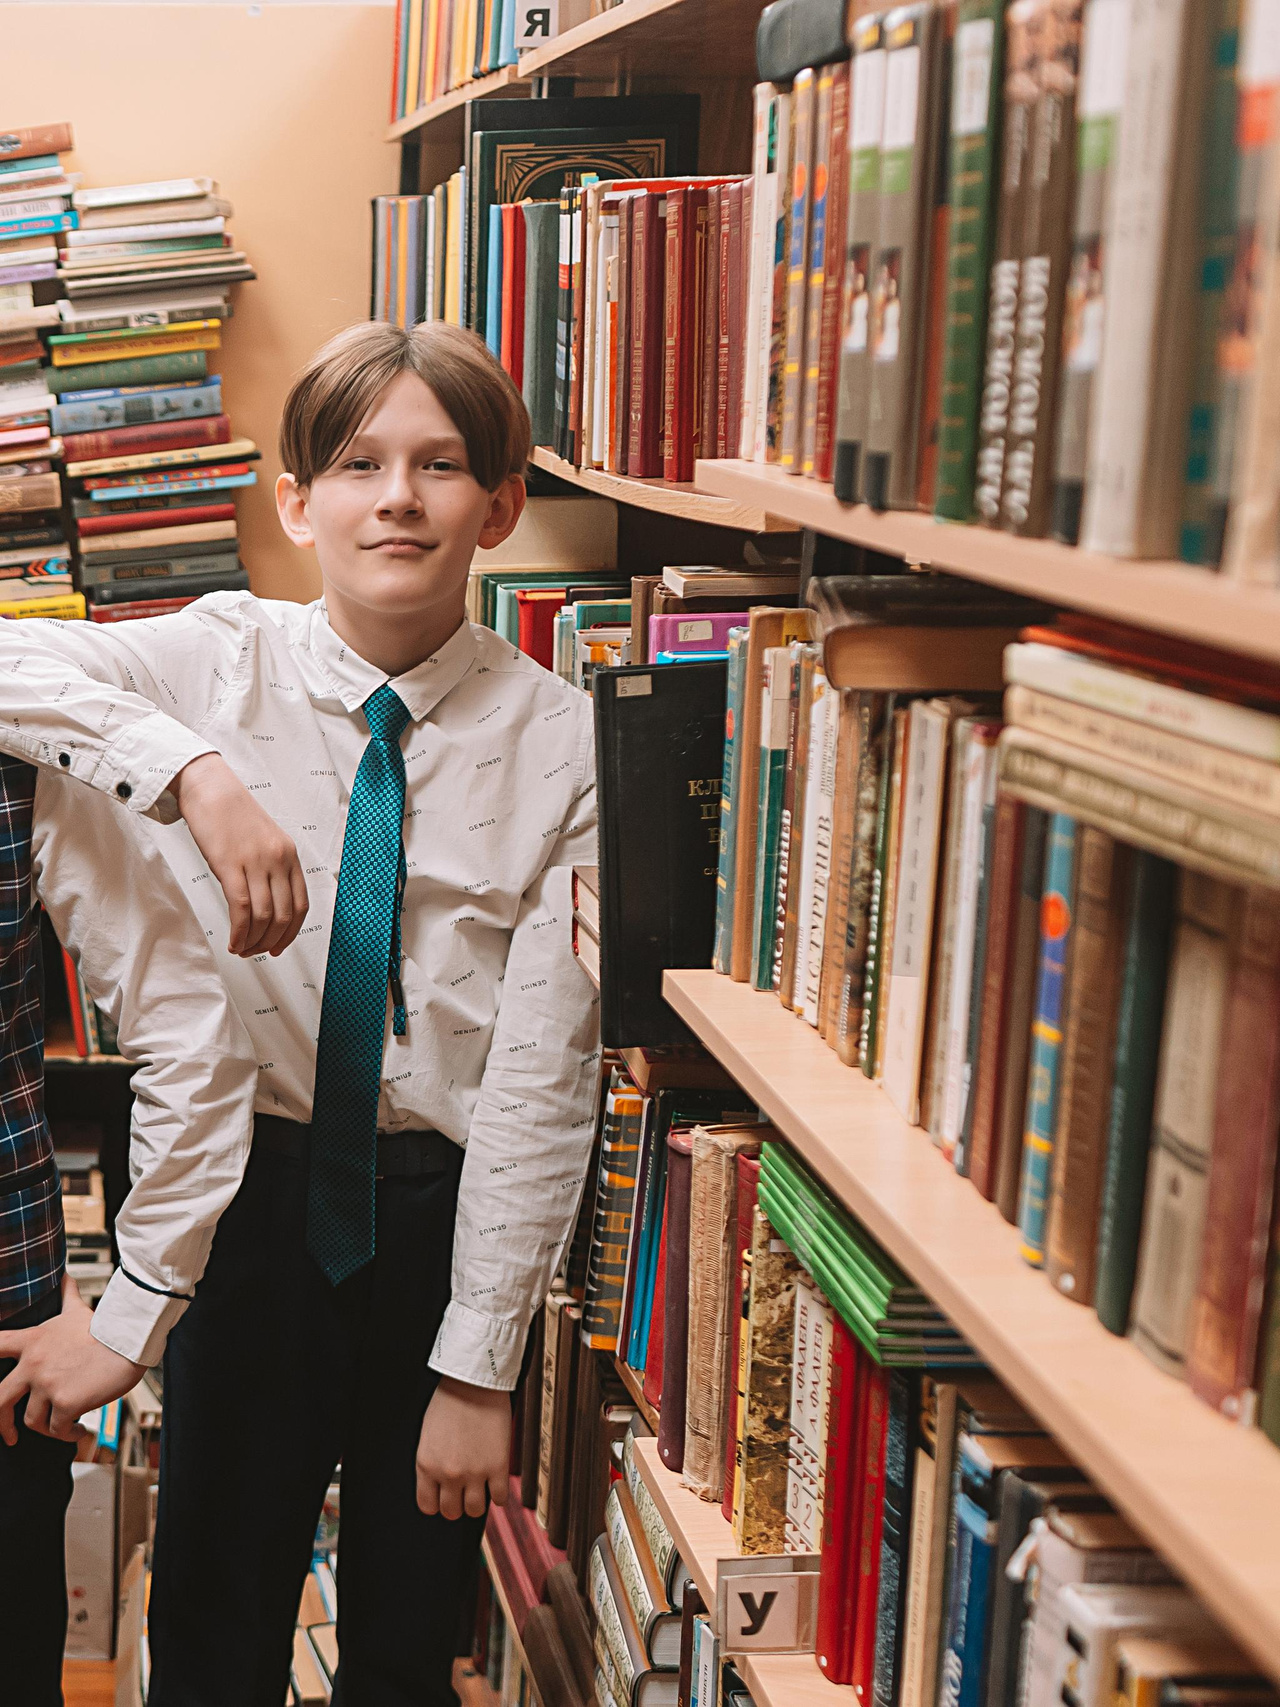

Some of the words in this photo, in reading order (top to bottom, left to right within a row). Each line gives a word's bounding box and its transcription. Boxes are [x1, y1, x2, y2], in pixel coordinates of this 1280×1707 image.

[524, 8, 550, 38] Я
[213, 668, 229, 687] GENIU
[161, 679, 178, 705] GENIUS
[100, 703, 116, 728] GENIUS
[477, 705, 502, 723] GENIUS
[544, 706, 571, 722] GENIUS
[252, 734, 275, 742] GENIUS
[476, 756, 502, 770] GENIUS
[148, 766, 178, 776] GENIUS
[309, 769, 337, 777] GENIUS
[544, 761, 570, 780] GENIUS
[468, 817, 496, 832] GENIUS
[542, 824, 562, 839] ENIUS
[306, 865, 328, 875] GENIU
[192, 872, 211, 884] ENIUS
[809, 815, 832, 946] ТУРГЕНЕВ
[464, 879, 491, 892] GENIUS
[532, 917, 558, 930] GENIUS
[450, 969, 476, 987] GENIUS
[520, 979, 548, 992] GENIUS
[254, 1005, 279, 1016] GENIUS
[453, 1026, 481, 1036] GENIUS
[508, 1041, 538, 1053] GENIUS
[386, 1071, 412, 1084] GENIUS
[499, 1101, 528, 1114] GENIUS
[571, 1115, 595, 1129] GENIUS
[489, 1162, 518, 1174] GENIUS
[479, 1224, 507, 1237] GENIUS
[471, 1285, 497, 1297] GENIUS
[796, 1303, 809, 1393] ФАДЕЕВ
[487, 1348, 497, 1376] GENIUS
[809, 1321, 824, 1409] ФАДЕЕВ
[737, 1591, 779, 1636] У
